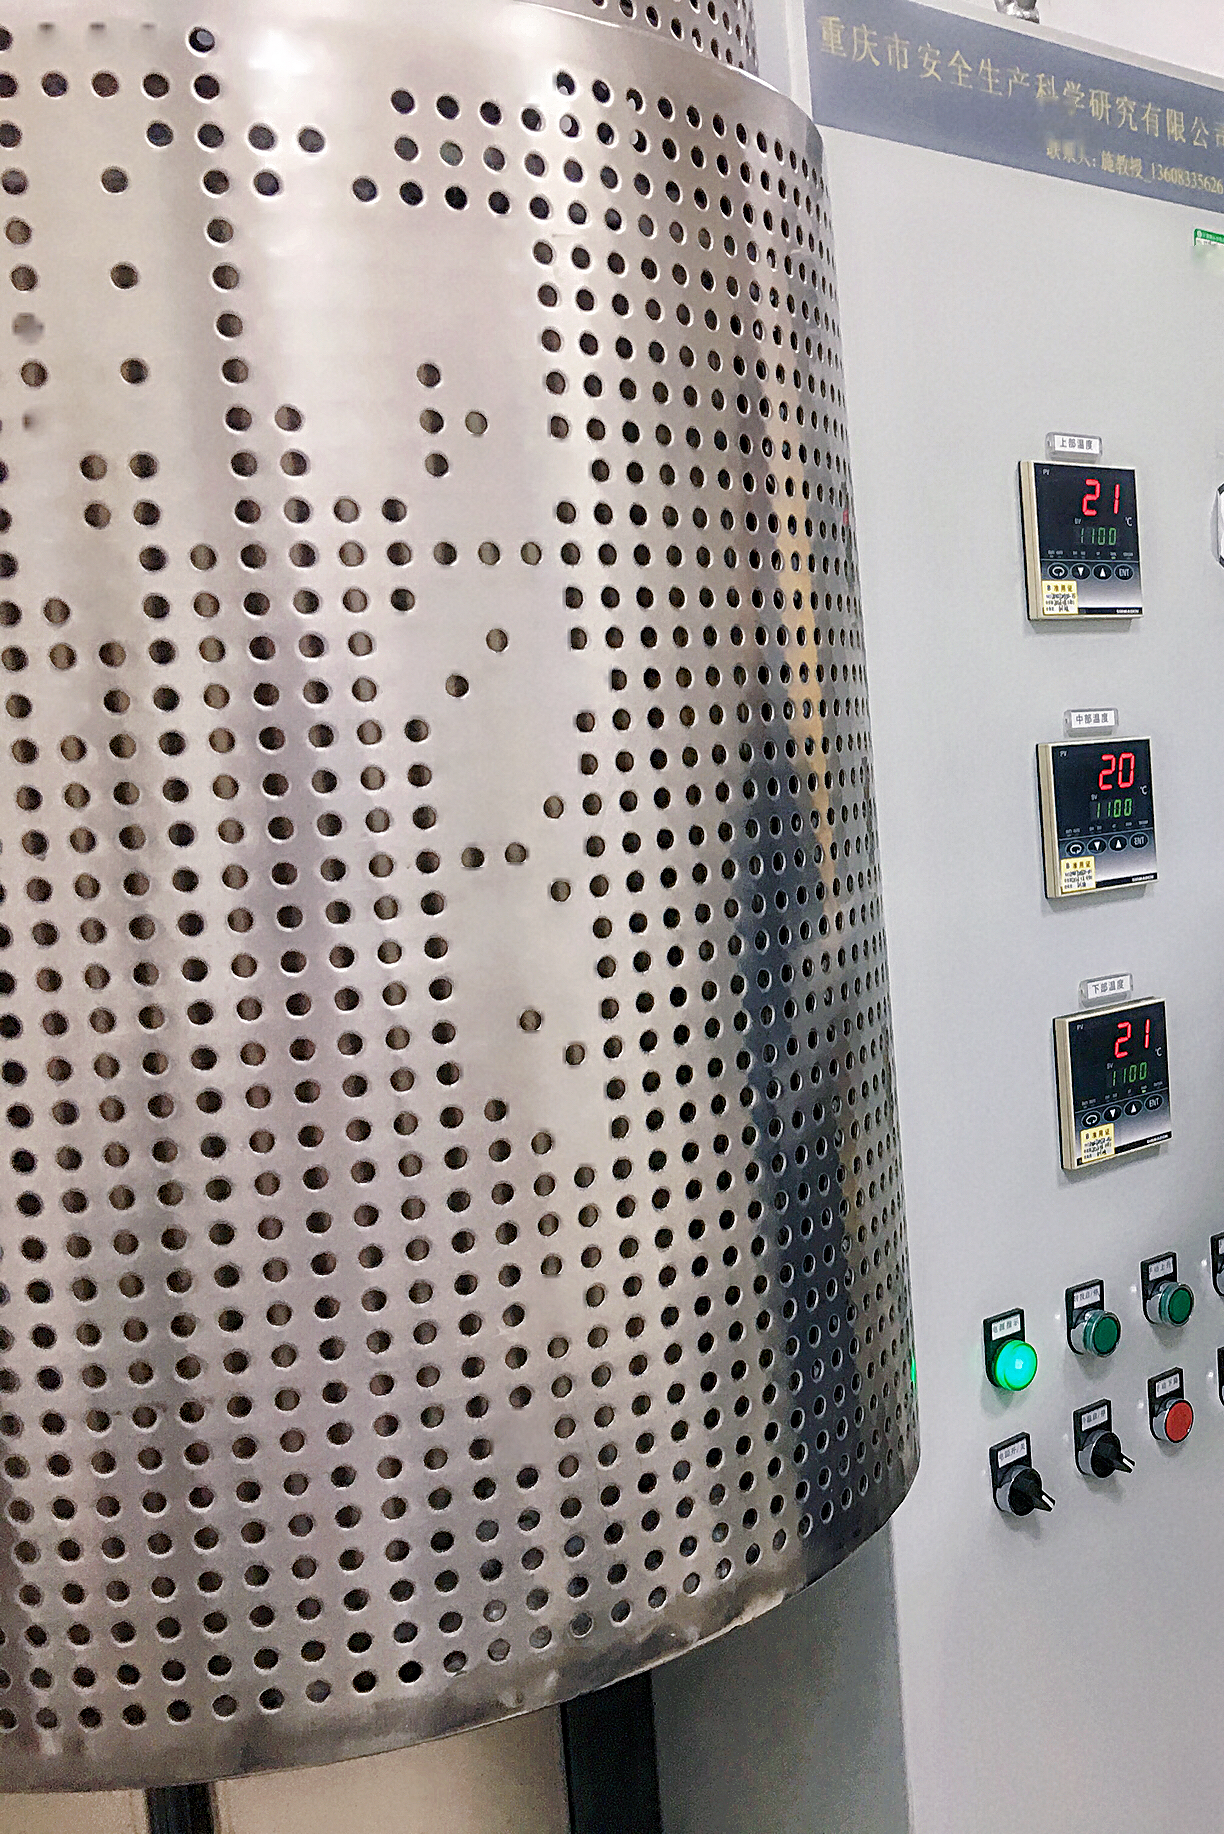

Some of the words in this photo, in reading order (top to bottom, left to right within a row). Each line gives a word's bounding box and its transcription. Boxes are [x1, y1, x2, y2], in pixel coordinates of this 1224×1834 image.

[1082, 479, 1120, 516] 21
[1080, 527, 1117, 546] 1100
[1098, 752, 1136, 791] 20
[1096, 798, 1133, 819] 1100
[1114, 1018, 1151, 1059] 21
[1112, 1061, 1148, 1087] 1100
